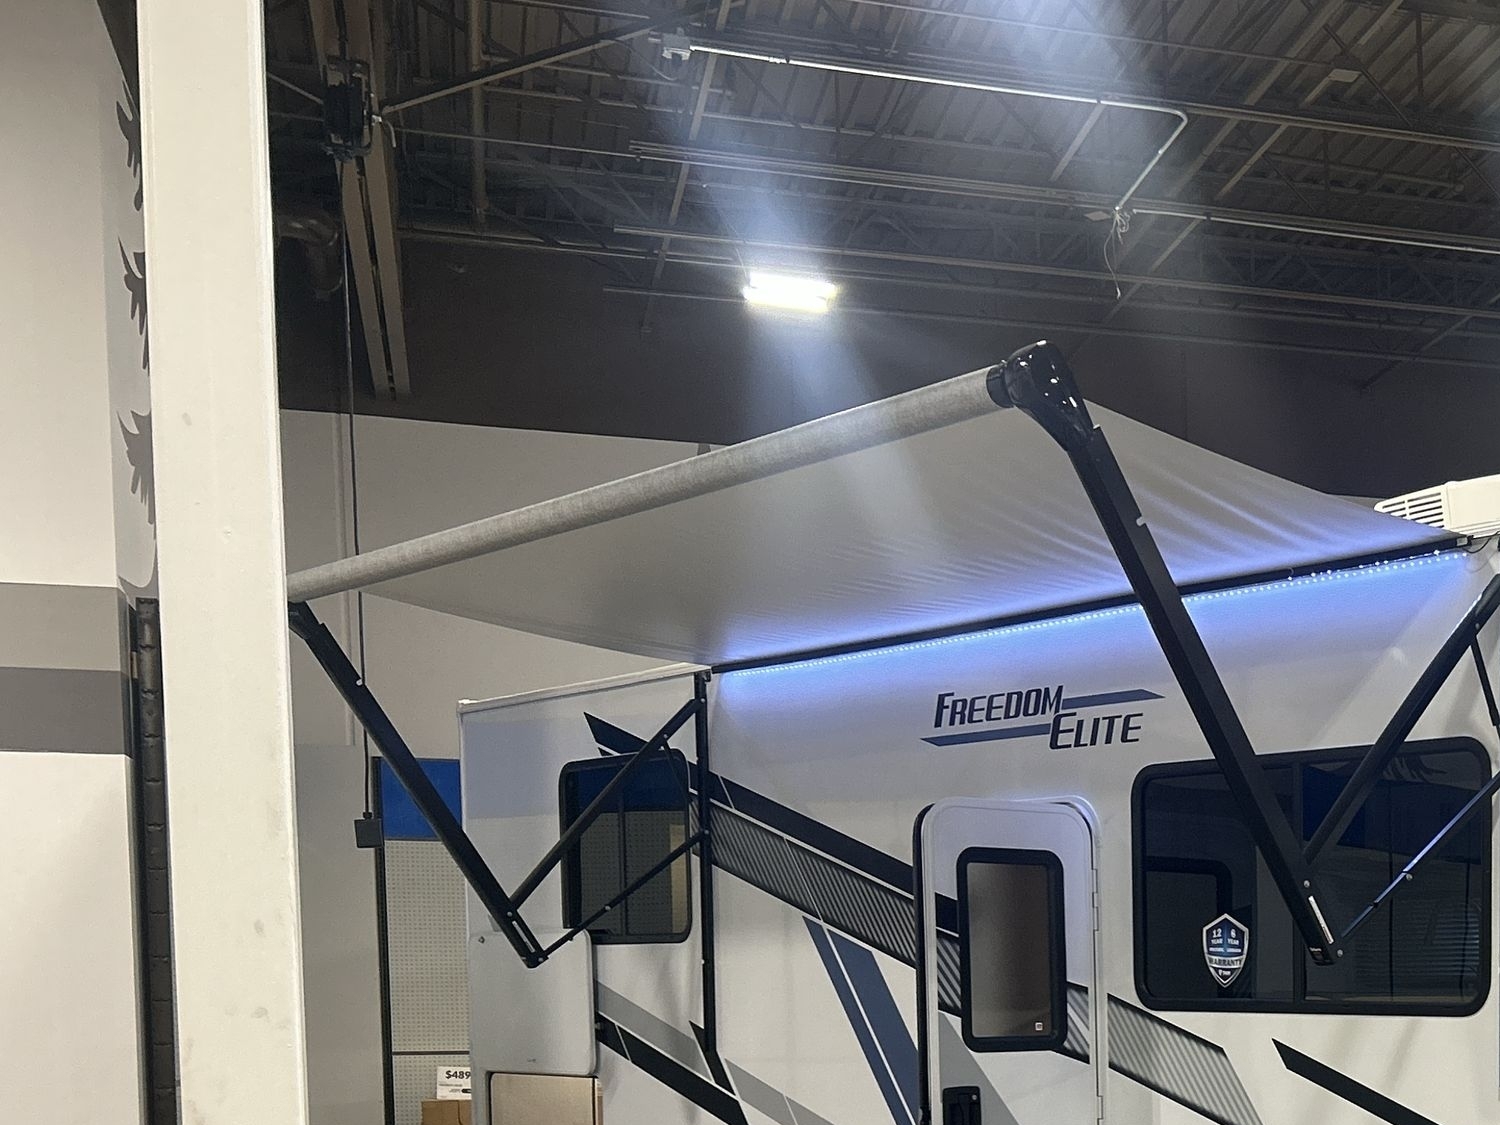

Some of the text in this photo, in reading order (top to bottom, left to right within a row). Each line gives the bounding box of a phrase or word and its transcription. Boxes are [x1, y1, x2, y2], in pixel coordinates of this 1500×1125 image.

[933, 684, 1064, 729] FREEDOM
[1049, 711, 1144, 750] ELITE
[1212, 928, 1222, 938] 12
